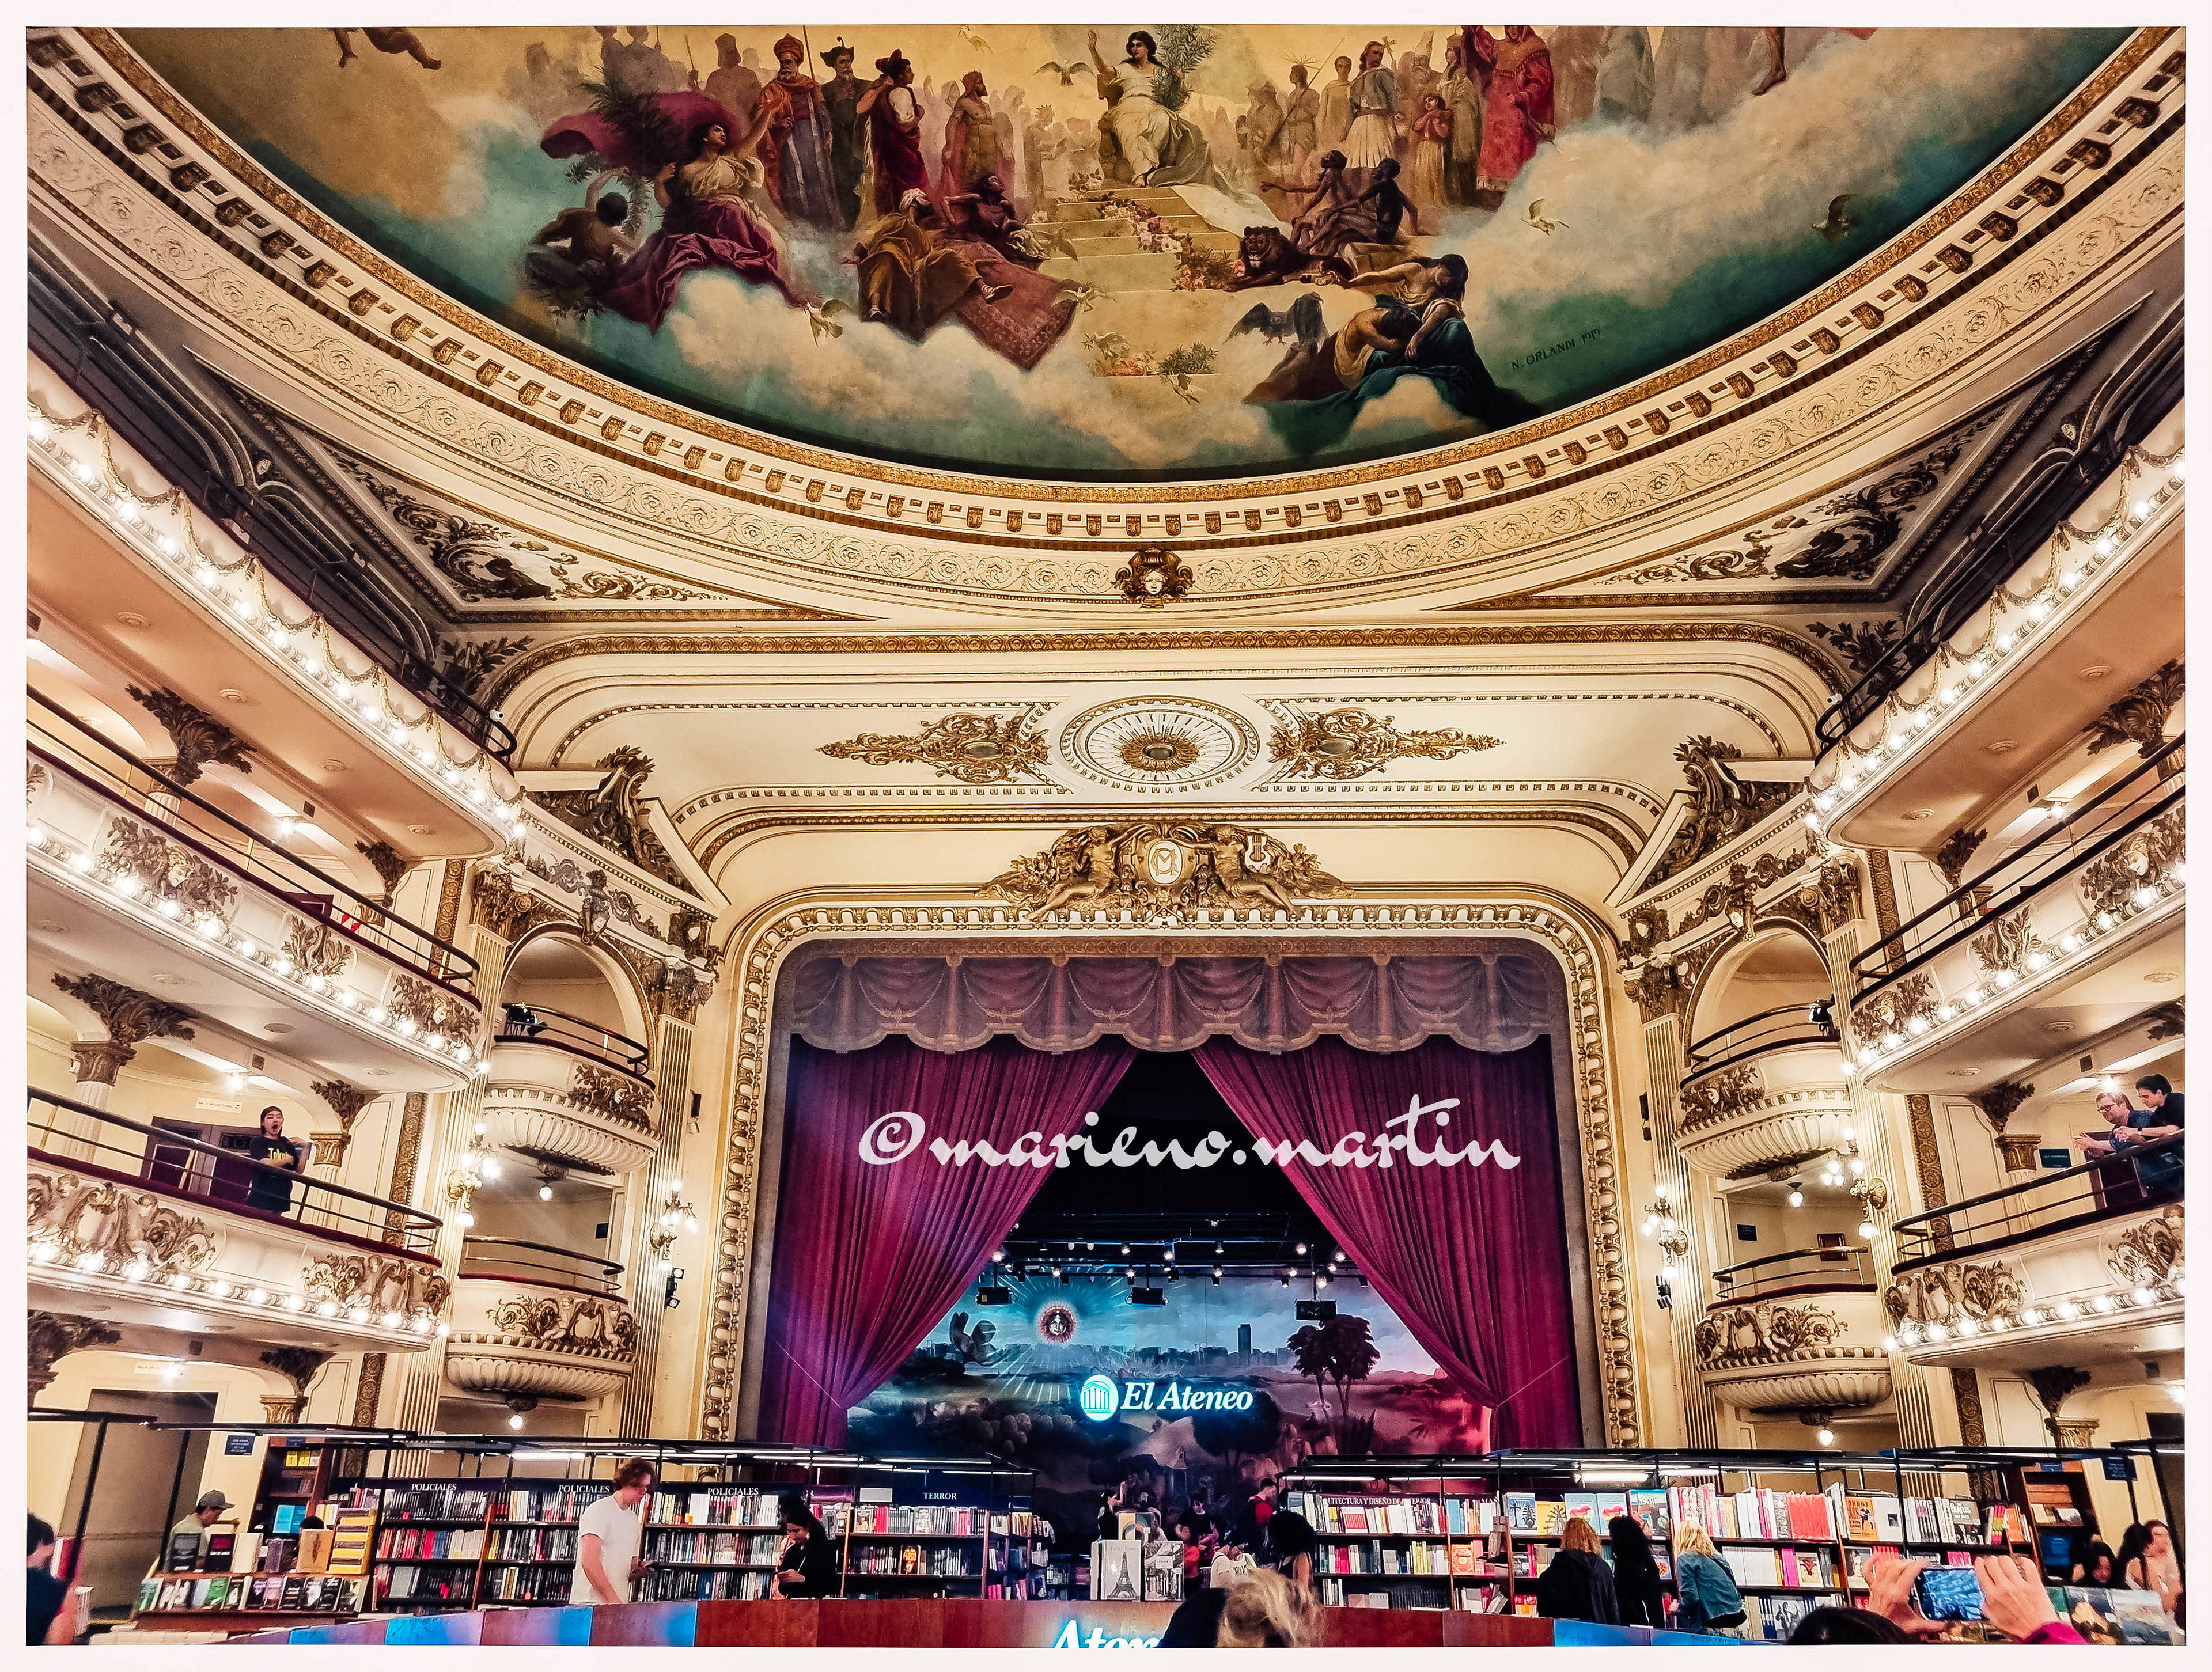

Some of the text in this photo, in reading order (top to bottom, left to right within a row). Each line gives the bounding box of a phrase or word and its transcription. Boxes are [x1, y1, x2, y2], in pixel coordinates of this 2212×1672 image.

[1525, 338, 1576, 365] ORLANDI
[1581, 328, 1601, 344] 1919
[1120, 1382, 1253, 1411] El Ateneo
[559, 1485, 610, 1493] POLICIALES
[707, 1488, 759, 1496] POLICIALES
[1847, 1507, 1860, 1519] ASH
